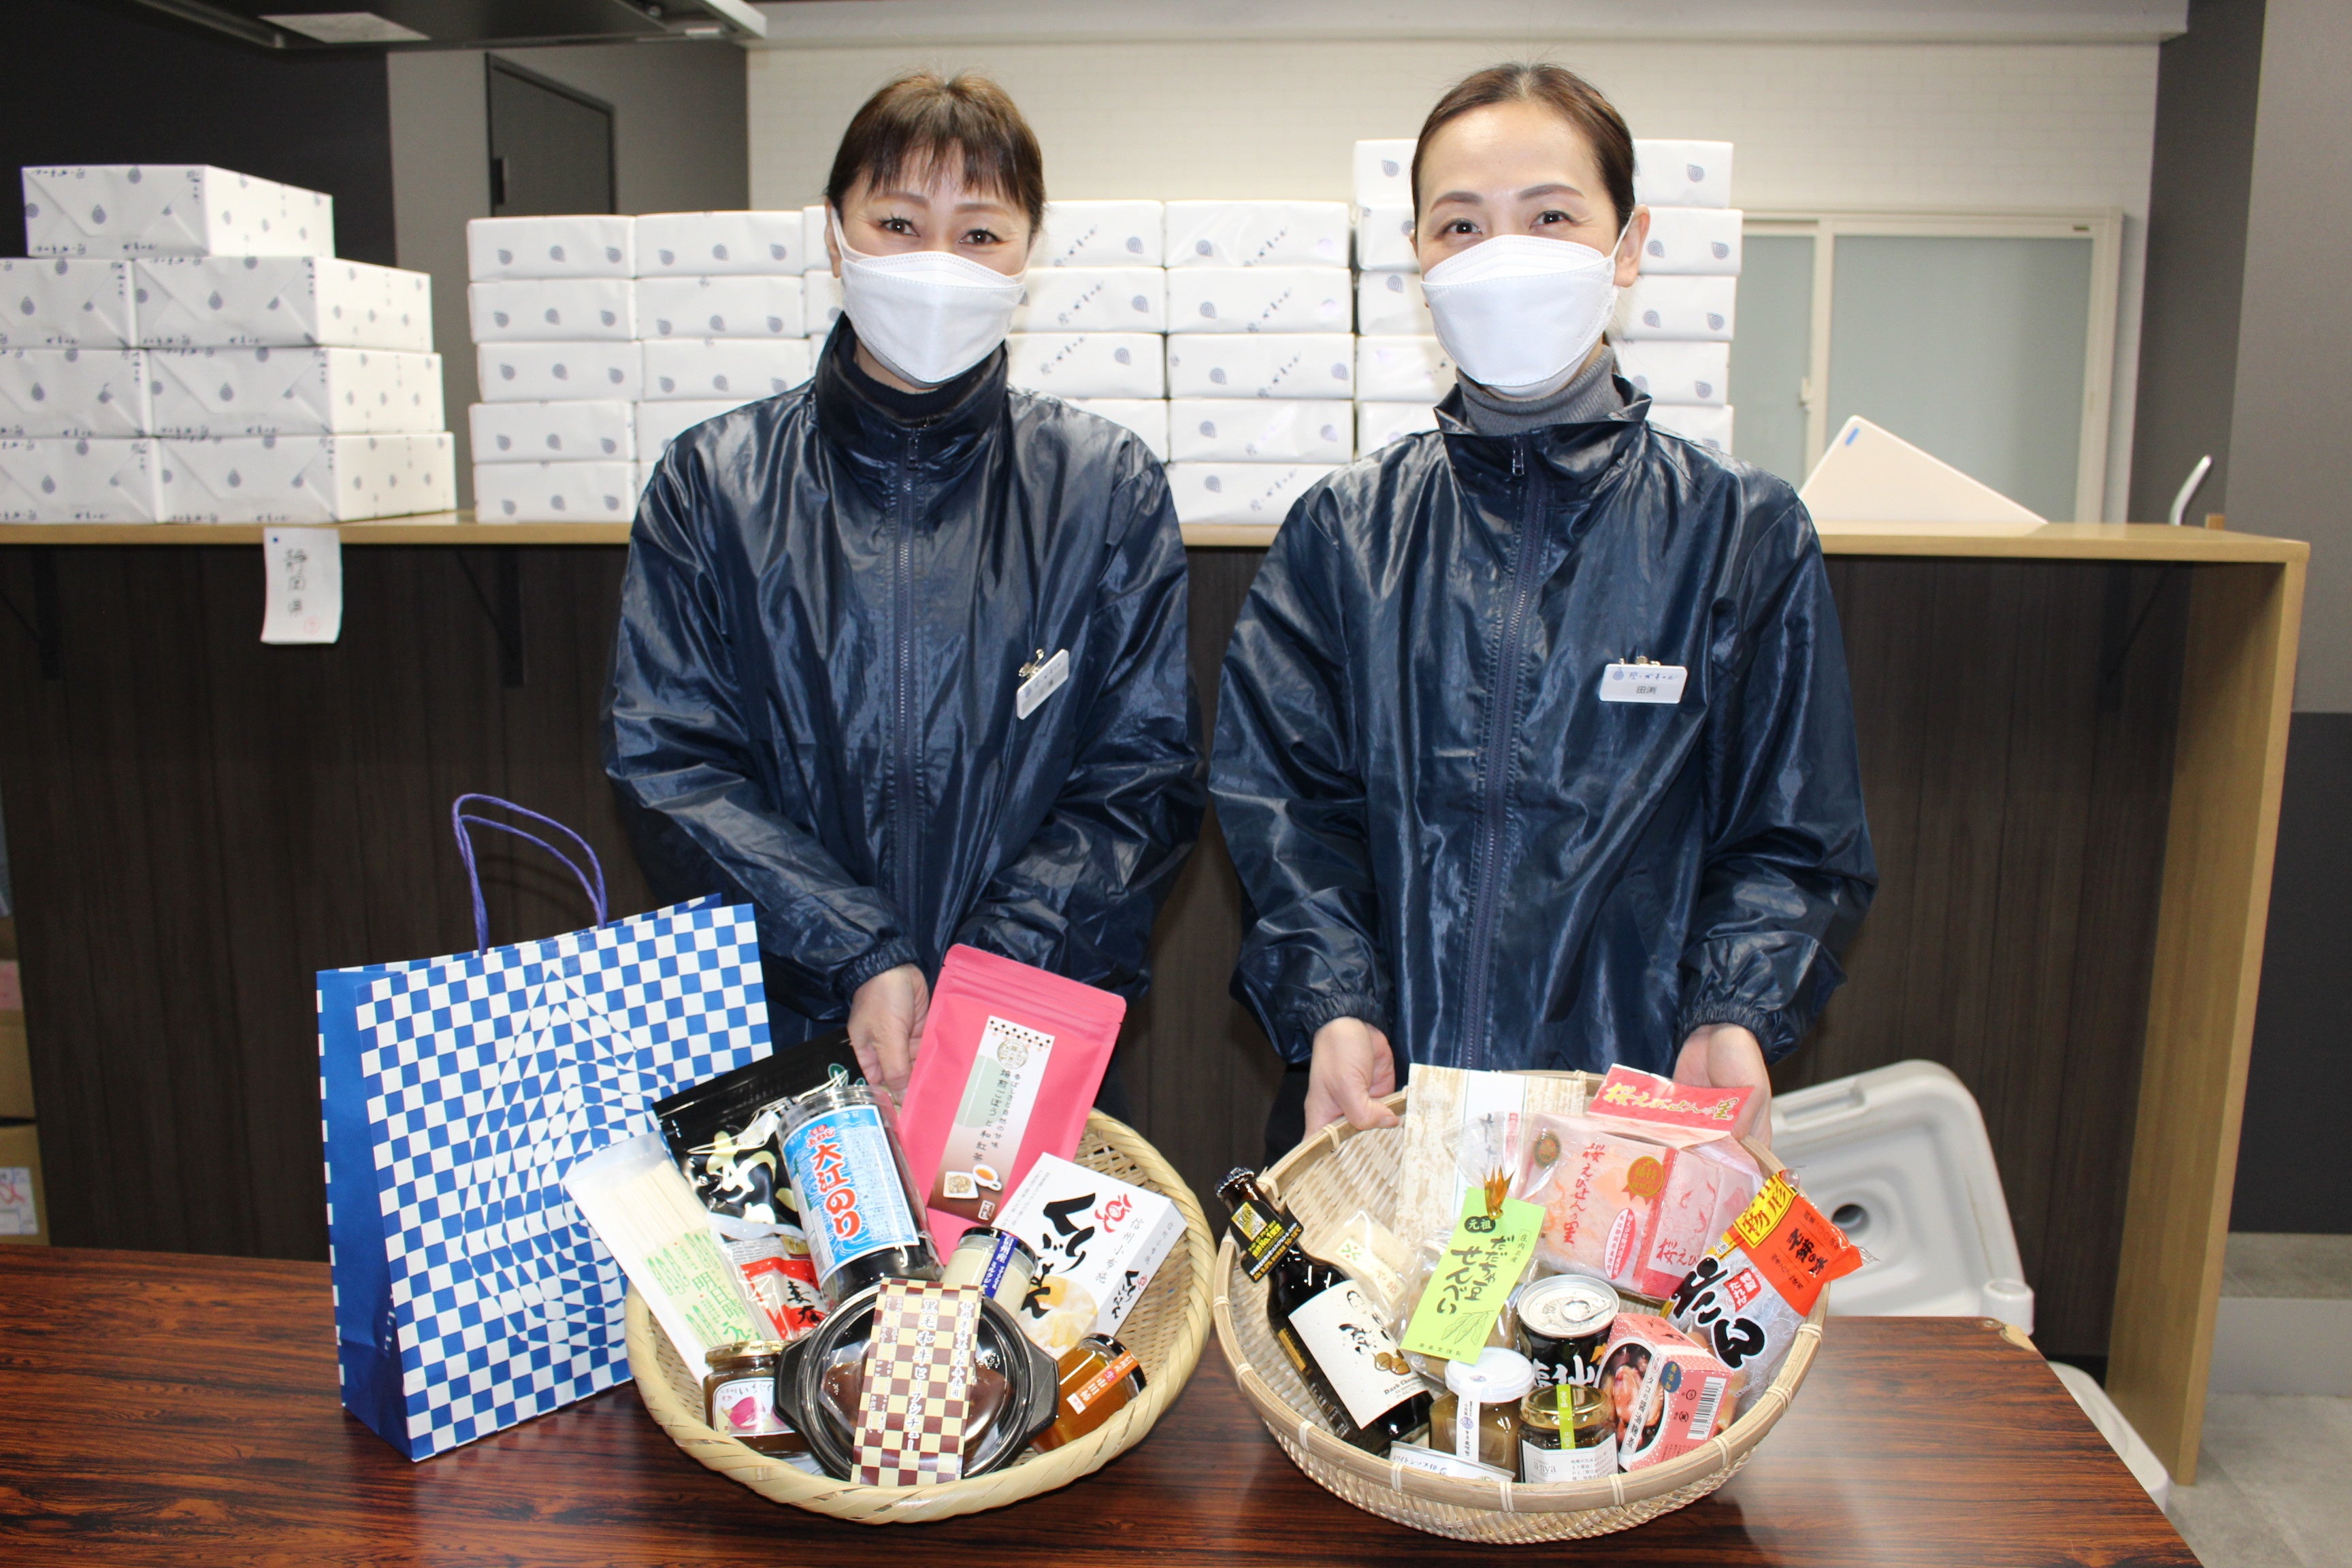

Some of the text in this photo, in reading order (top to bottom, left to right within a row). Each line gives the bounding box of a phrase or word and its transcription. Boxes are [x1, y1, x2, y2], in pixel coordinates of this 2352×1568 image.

[812, 1143, 862, 1239] 大江のり
[1468, 1219, 1492, 1231] 元祖
[1437, 1245, 1484, 1316] せんべい
[1464, 1235, 1516, 1301] だだちゃ豆
[1740, 1272, 1759, 1294] 特製
[1728, 1281, 1749, 1307] たれ付
